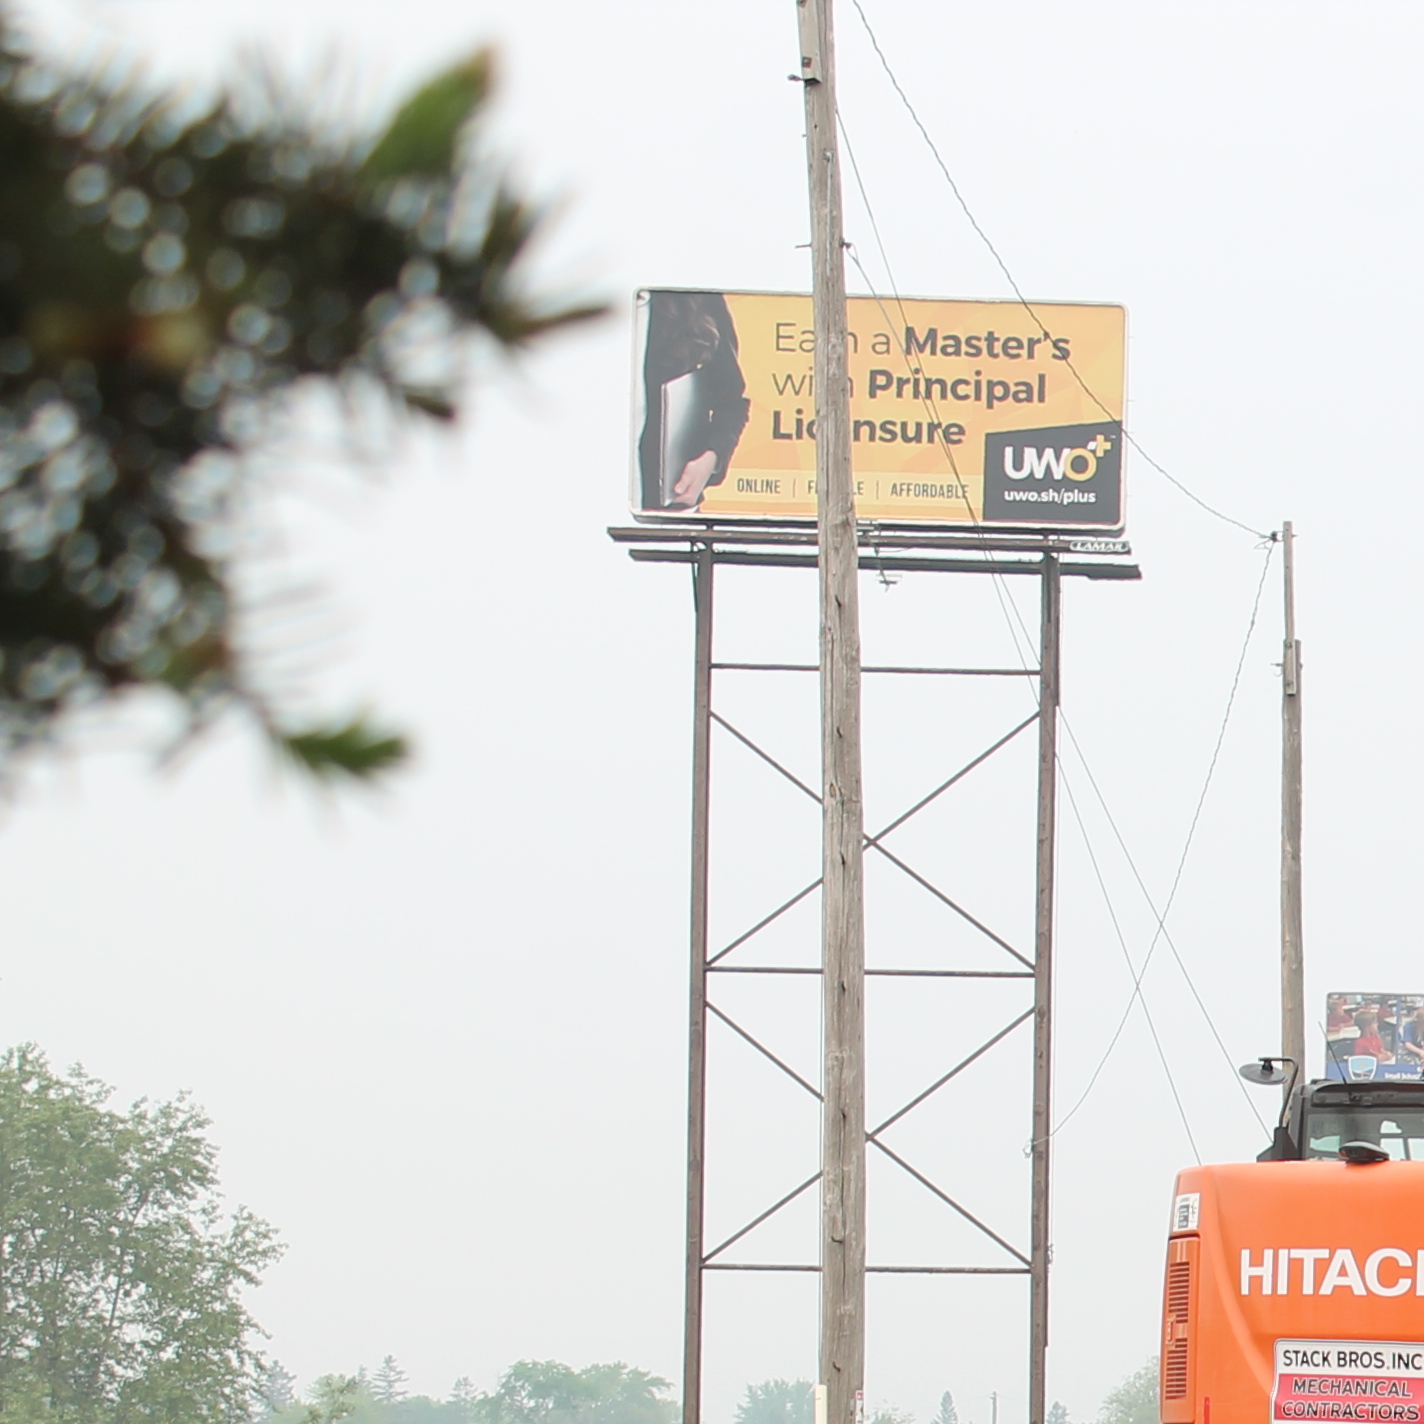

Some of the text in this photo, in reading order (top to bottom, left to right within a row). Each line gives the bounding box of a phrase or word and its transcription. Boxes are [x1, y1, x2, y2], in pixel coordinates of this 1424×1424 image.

[775, 322, 1070, 361] Ean a Master's
[868, 368, 1046, 409] Principal
[772, 407, 966, 446] Licnsure
[737, 478, 969, 499] ONLINE AFFORDABLE
[1004, 488, 1096, 505] uwo.sh/plus
[1282, 1349, 1332, 1368] STACK
[1292, 1378, 1412, 1398] MECHANICAL
[1281, 1401, 1420, 1421] CONTRACTORS
